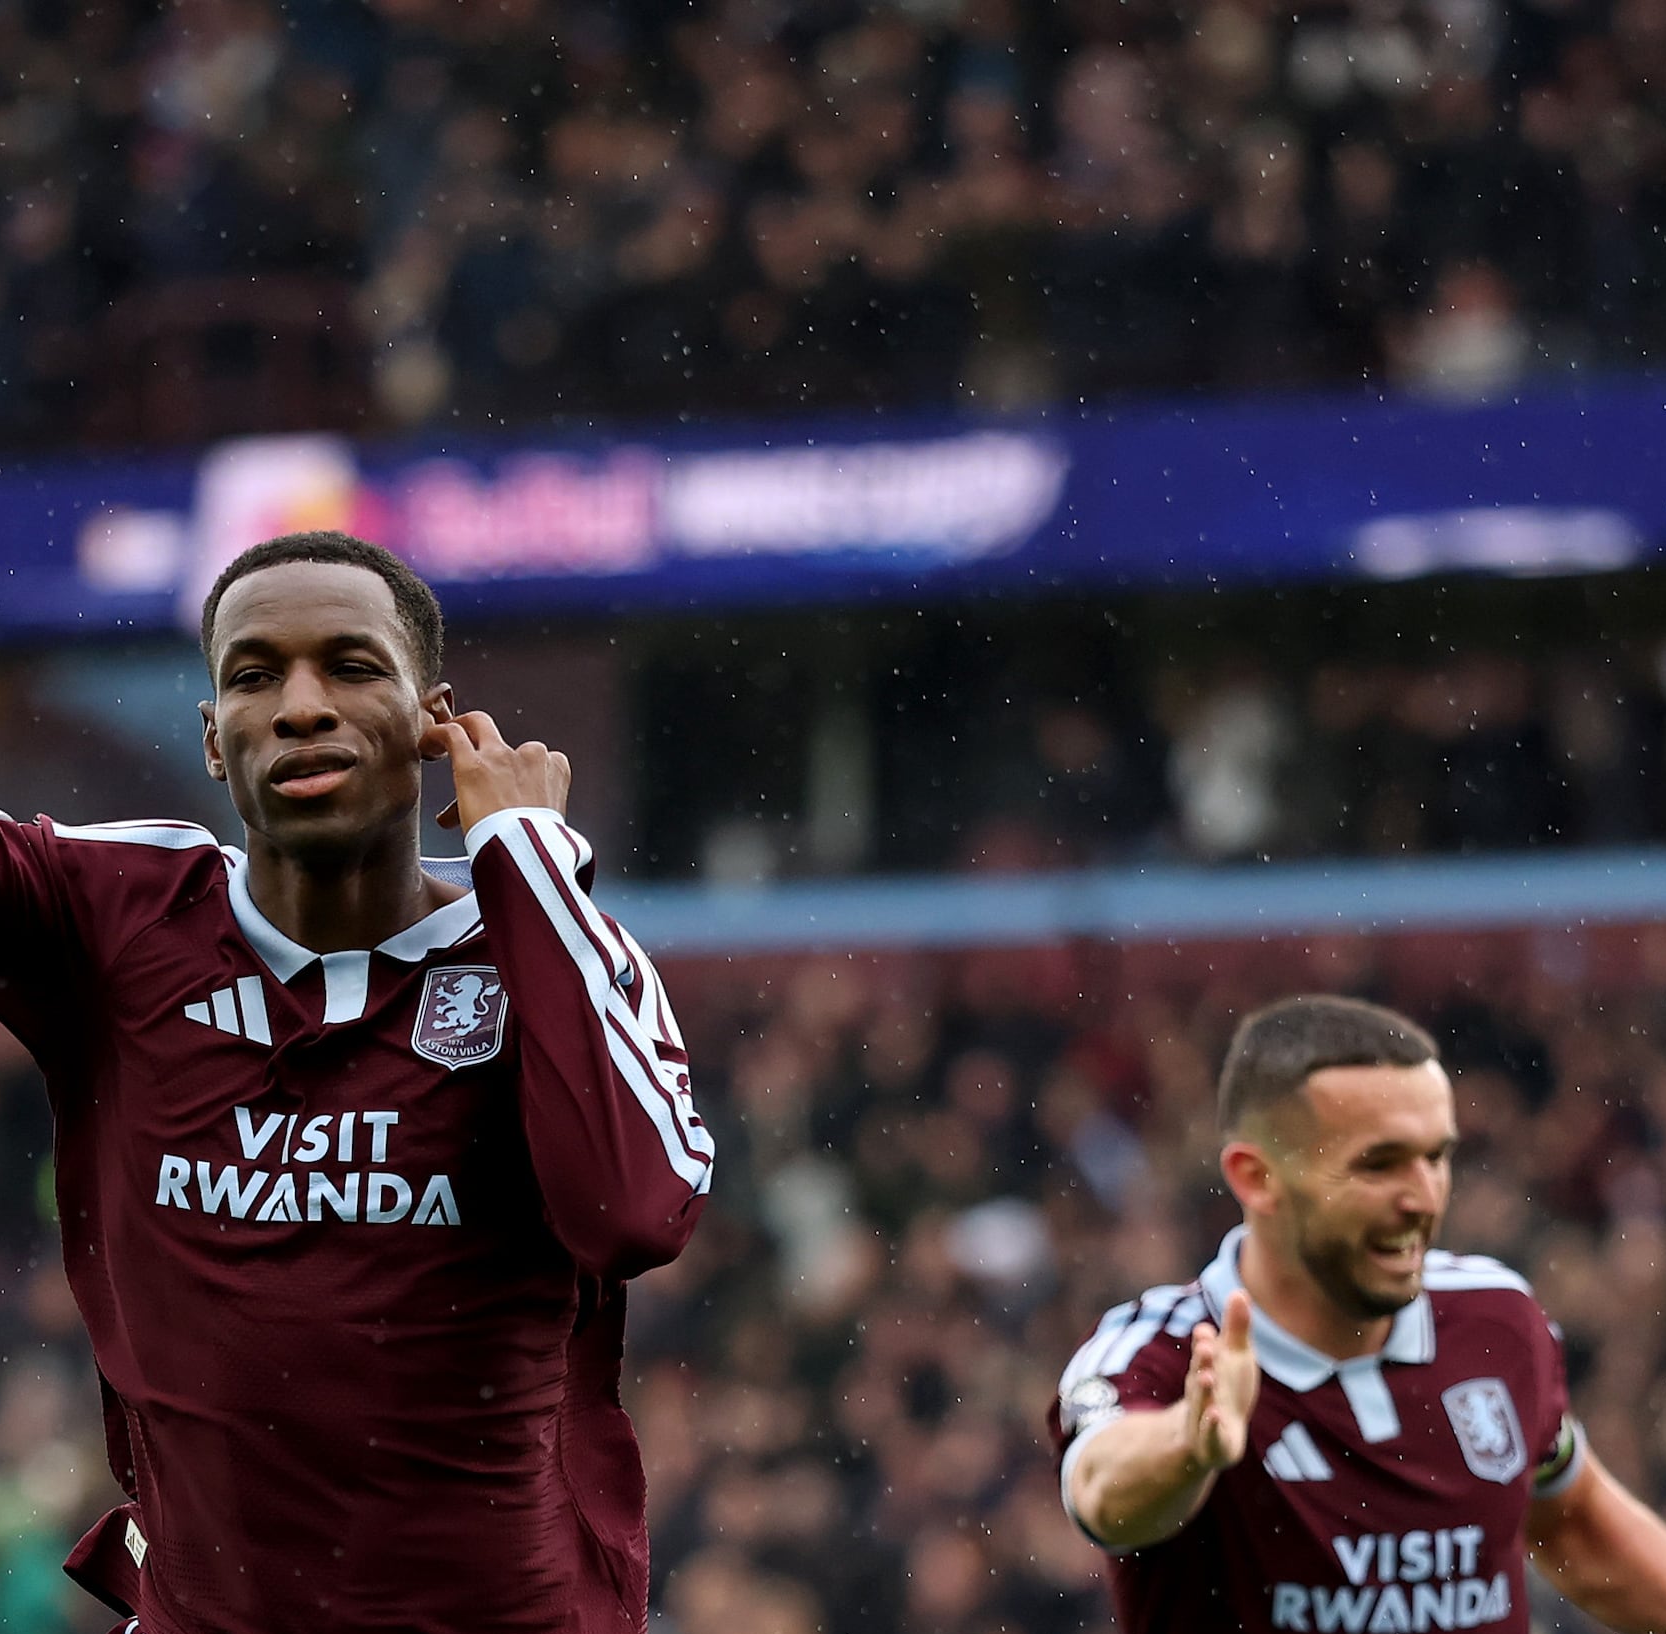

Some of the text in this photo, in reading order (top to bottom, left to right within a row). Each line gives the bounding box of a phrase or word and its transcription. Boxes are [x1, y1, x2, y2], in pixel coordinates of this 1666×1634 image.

[424, 1039, 491, 1056] ASTON VILLA
[234, 1105, 399, 1164] VISIT
[156, 1154, 462, 1226] RWANDA
[1333, 1525, 1485, 1585] VISIT
